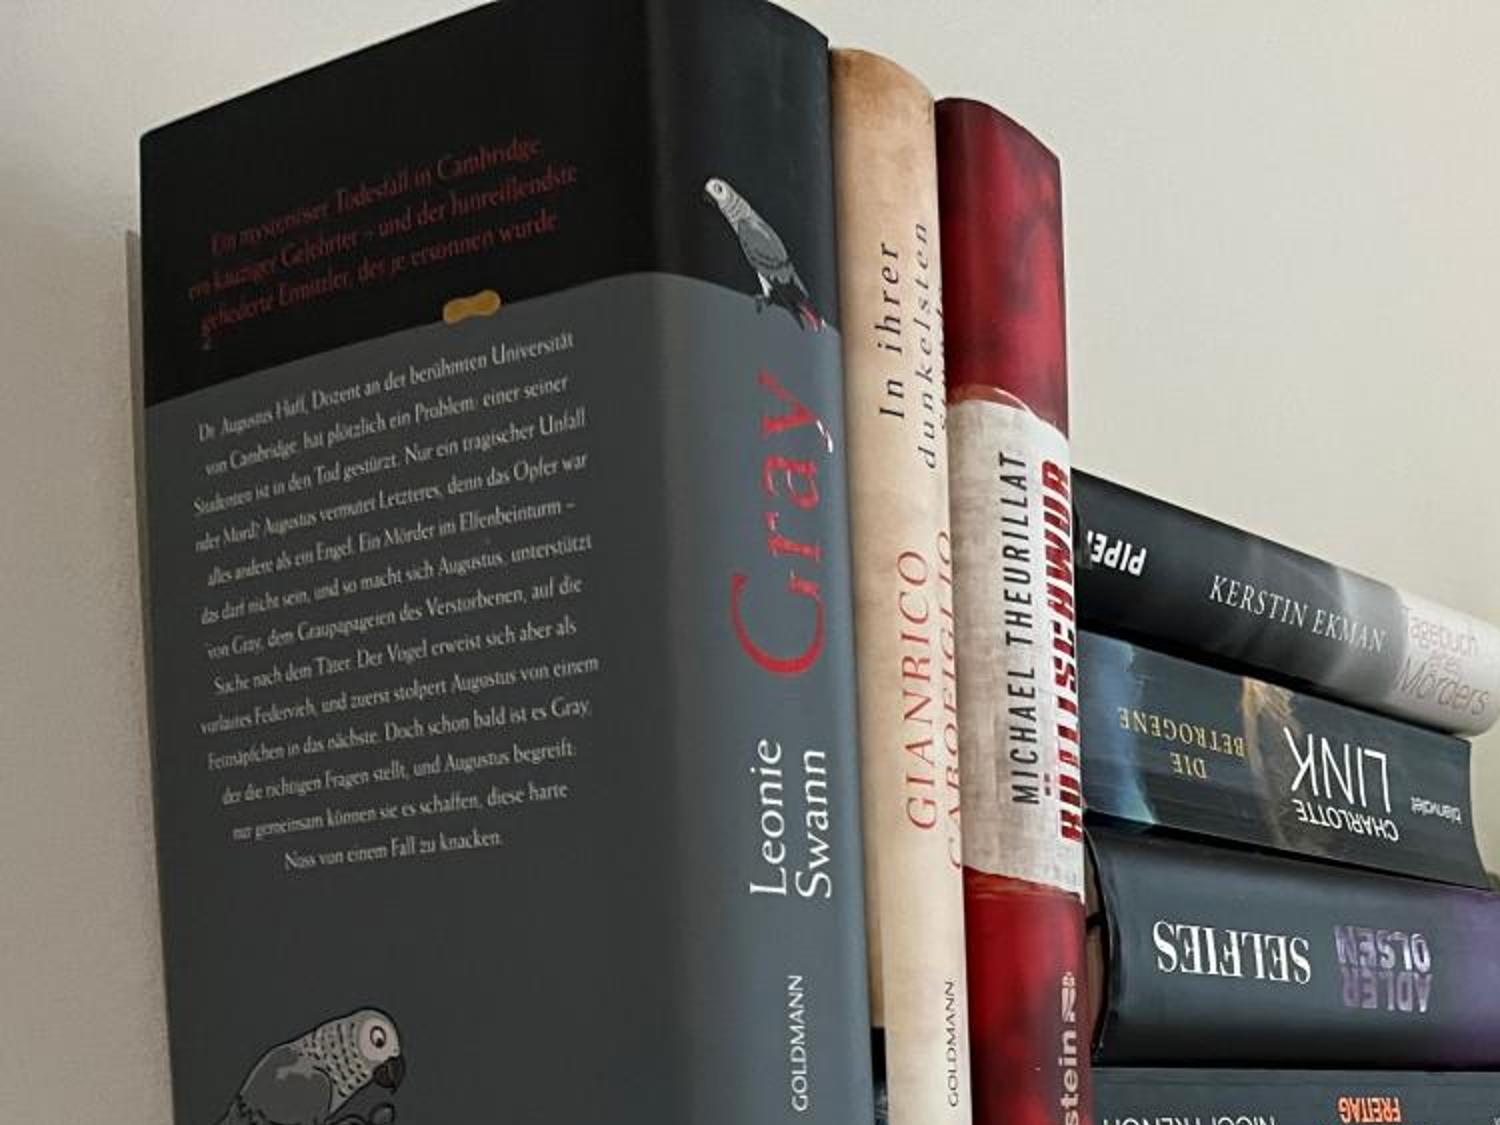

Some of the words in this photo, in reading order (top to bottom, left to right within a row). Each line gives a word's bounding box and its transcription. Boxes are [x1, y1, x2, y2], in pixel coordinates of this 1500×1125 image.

[874, 241, 903, 355] ihrer
[312, 384, 359, 409] Dozent
[364, 380, 380, 396] an
[384, 370, 404, 391] der
[410, 355, 486, 384] berühmten
[492, 333, 572, 364] Universität
[913, 223, 937, 469] dunkelsten
[303, 431, 323, 448] hat
[328, 412, 385, 447] plötzlich
[389, 411, 410, 429] ein
[483, 387, 519, 407] einer
[524, 377, 567, 398] seiner
[879, 379, 905, 420] In
[288, 472, 310, 491] den
[313, 460, 340, 484] Tod
[405, 443, 432, 464] Nur
[436, 440, 457, 457] ein
[463, 423, 534, 451] tragischer
[539, 407, 585, 435] Unfall
[448, 474, 482, 494] denn
[486, 466, 509, 486] das
[513, 456, 557, 481] Opfer
[562, 454, 586, 470] war
[359, 532, 381, 552] Ein
[384, 521, 434, 545] Mörder
[439, 521, 455, 536] im
[460, 501, 560, 530] Elfenbeinturm
[730, 368, 833, 674] Gray
[999, 451, 1034, 648] THEURILLAT
[1086, 529, 1147, 577] PIPE
[314, 577, 338, 600] und
[342, 580, 356, 593] so
[361, 566, 401, 589] macht
[406, 559, 433, 581] sich
[512, 535, 591, 562] unterstützt
[298, 611, 395, 640] Graupapageien
[399, 602, 422, 622] des
[426, 589, 526, 615] Verstorbenen,
[531, 576, 553, 599] auf
[559, 575, 582, 595] die
[1209, 574, 1307, 628] KERSTIN
[1312, 608, 1391, 653] EKMAN
[253, 664, 281, 687] nach
[285, 662, 311, 682] dem
[357, 648, 382, 668] Der
[387, 639, 426, 663] Vogel
[431, 635, 481, 655] erweist
[486, 624, 514, 645] sich
[519, 621, 551, 641] aber
[556, 614, 576, 636] als
[321, 691, 346, 713] und
[394, 679, 446, 700] stolpert
[451, 671, 515, 693] Augustus
[520, 665, 548, 680] von
[553, 658, 598, 677] einem
[897, 550, 937, 831] GIANRICO
[303, 735, 324, 753] das
[385, 718, 423, 741] Doch
[427, 713, 468, 735] schon
[474, 706, 505, 728] bald
[510, 707, 526, 723] ist
[531, 707, 547, 720] es
[1008, 667, 1040, 806] MICHAEL
[1119, 705, 1249, 758] BETROGENE
[325, 769, 368, 789] Fragen
[373, 759, 409, 781] stellt,
[413, 753, 440, 776] und
[445, 752, 509, 772] Augustus
[1169, 751, 1207, 780] DIE
[1283, 725, 1392, 813] LINK
[327, 807, 375, 826] können
[401, 803, 415, 816] es
[487, 786, 524, 806] diese
[528, 781, 569, 800] harte
[750, 738, 787, 896] Leonie
[795, 748, 832, 899] Swann
[1294, 799, 1400, 841] CHARLOTTE
[318, 850, 343, 864] von
[347, 845, 387, 862] einem
[391, 835, 414, 856] Fall
[420, 839, 435, 853] zu
[1152, 919, 1312, 985] SELFIES
[1334, 925, 1432, 975] OLSEN
[1340, 967, 1433, 1013] ADLER
[787, 974, 809, 1112] GOLDMANN
[944, 980, 959, 1108] GOLDMANN
[1336, 1096, 1402, 1124] FREITAG
